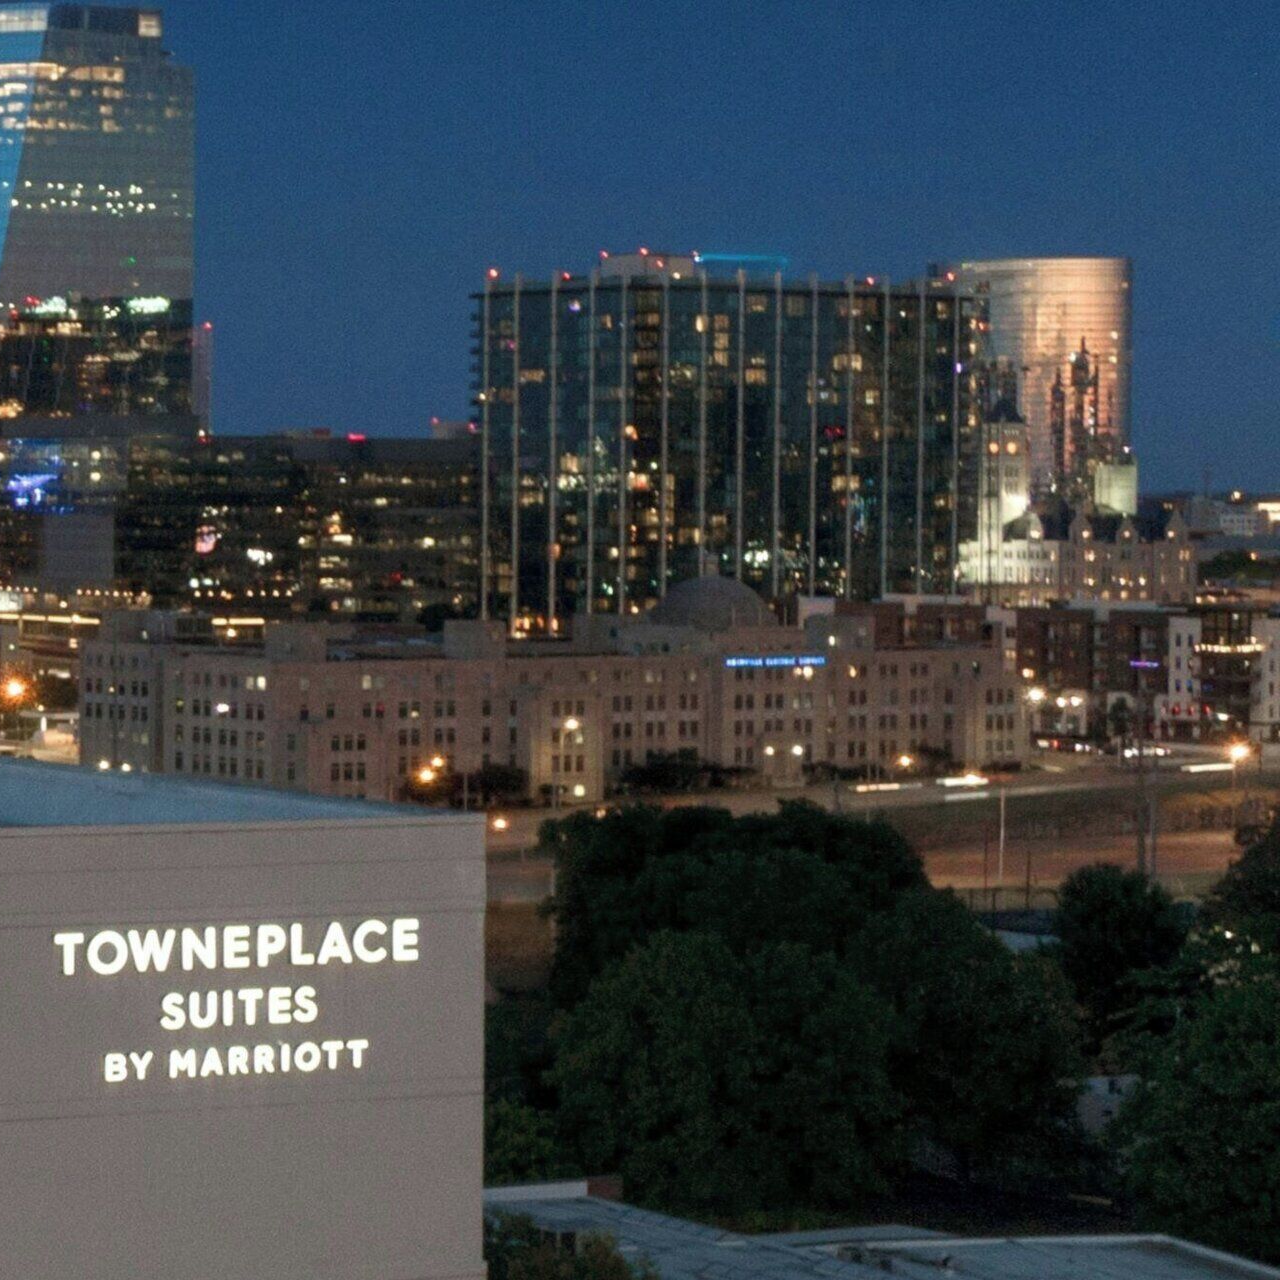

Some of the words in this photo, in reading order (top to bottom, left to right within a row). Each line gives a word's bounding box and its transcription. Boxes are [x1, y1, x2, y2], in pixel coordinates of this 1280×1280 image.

[53, 918, 420, 976] TOWNEPLACE
[160, 985, 319, 1030] SUITES
[104, 1050, 154, 1083] BY
[169, 1039, 370, 1079] MARRIOTT
